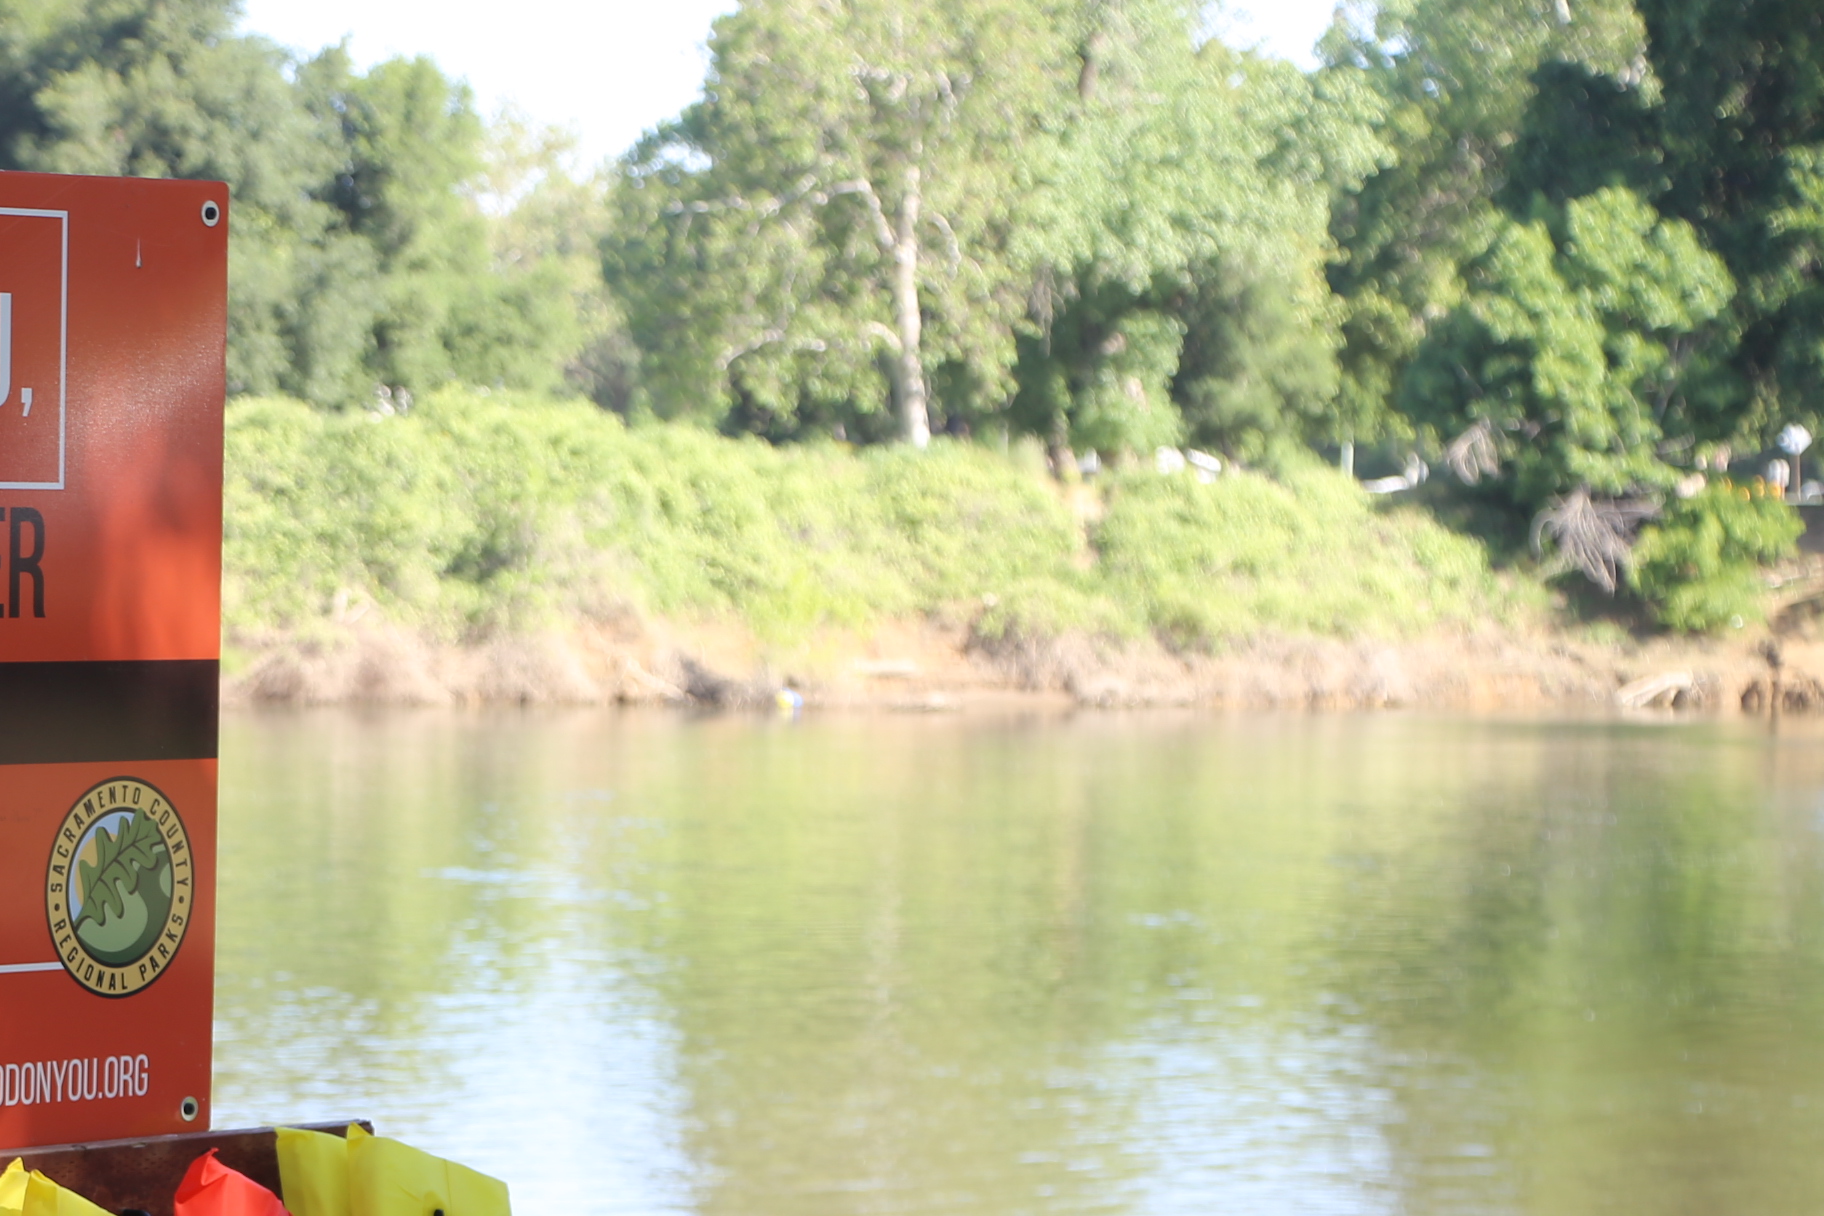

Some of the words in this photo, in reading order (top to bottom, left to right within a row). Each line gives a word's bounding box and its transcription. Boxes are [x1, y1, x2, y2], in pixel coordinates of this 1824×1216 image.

[50, 785, 142, 893] SACRAMENTO
[150, 798, 190, 887] COUNTY
[53, 917, 129, 991] REGIONAL
[139, 914, 184, 982] PARKS
